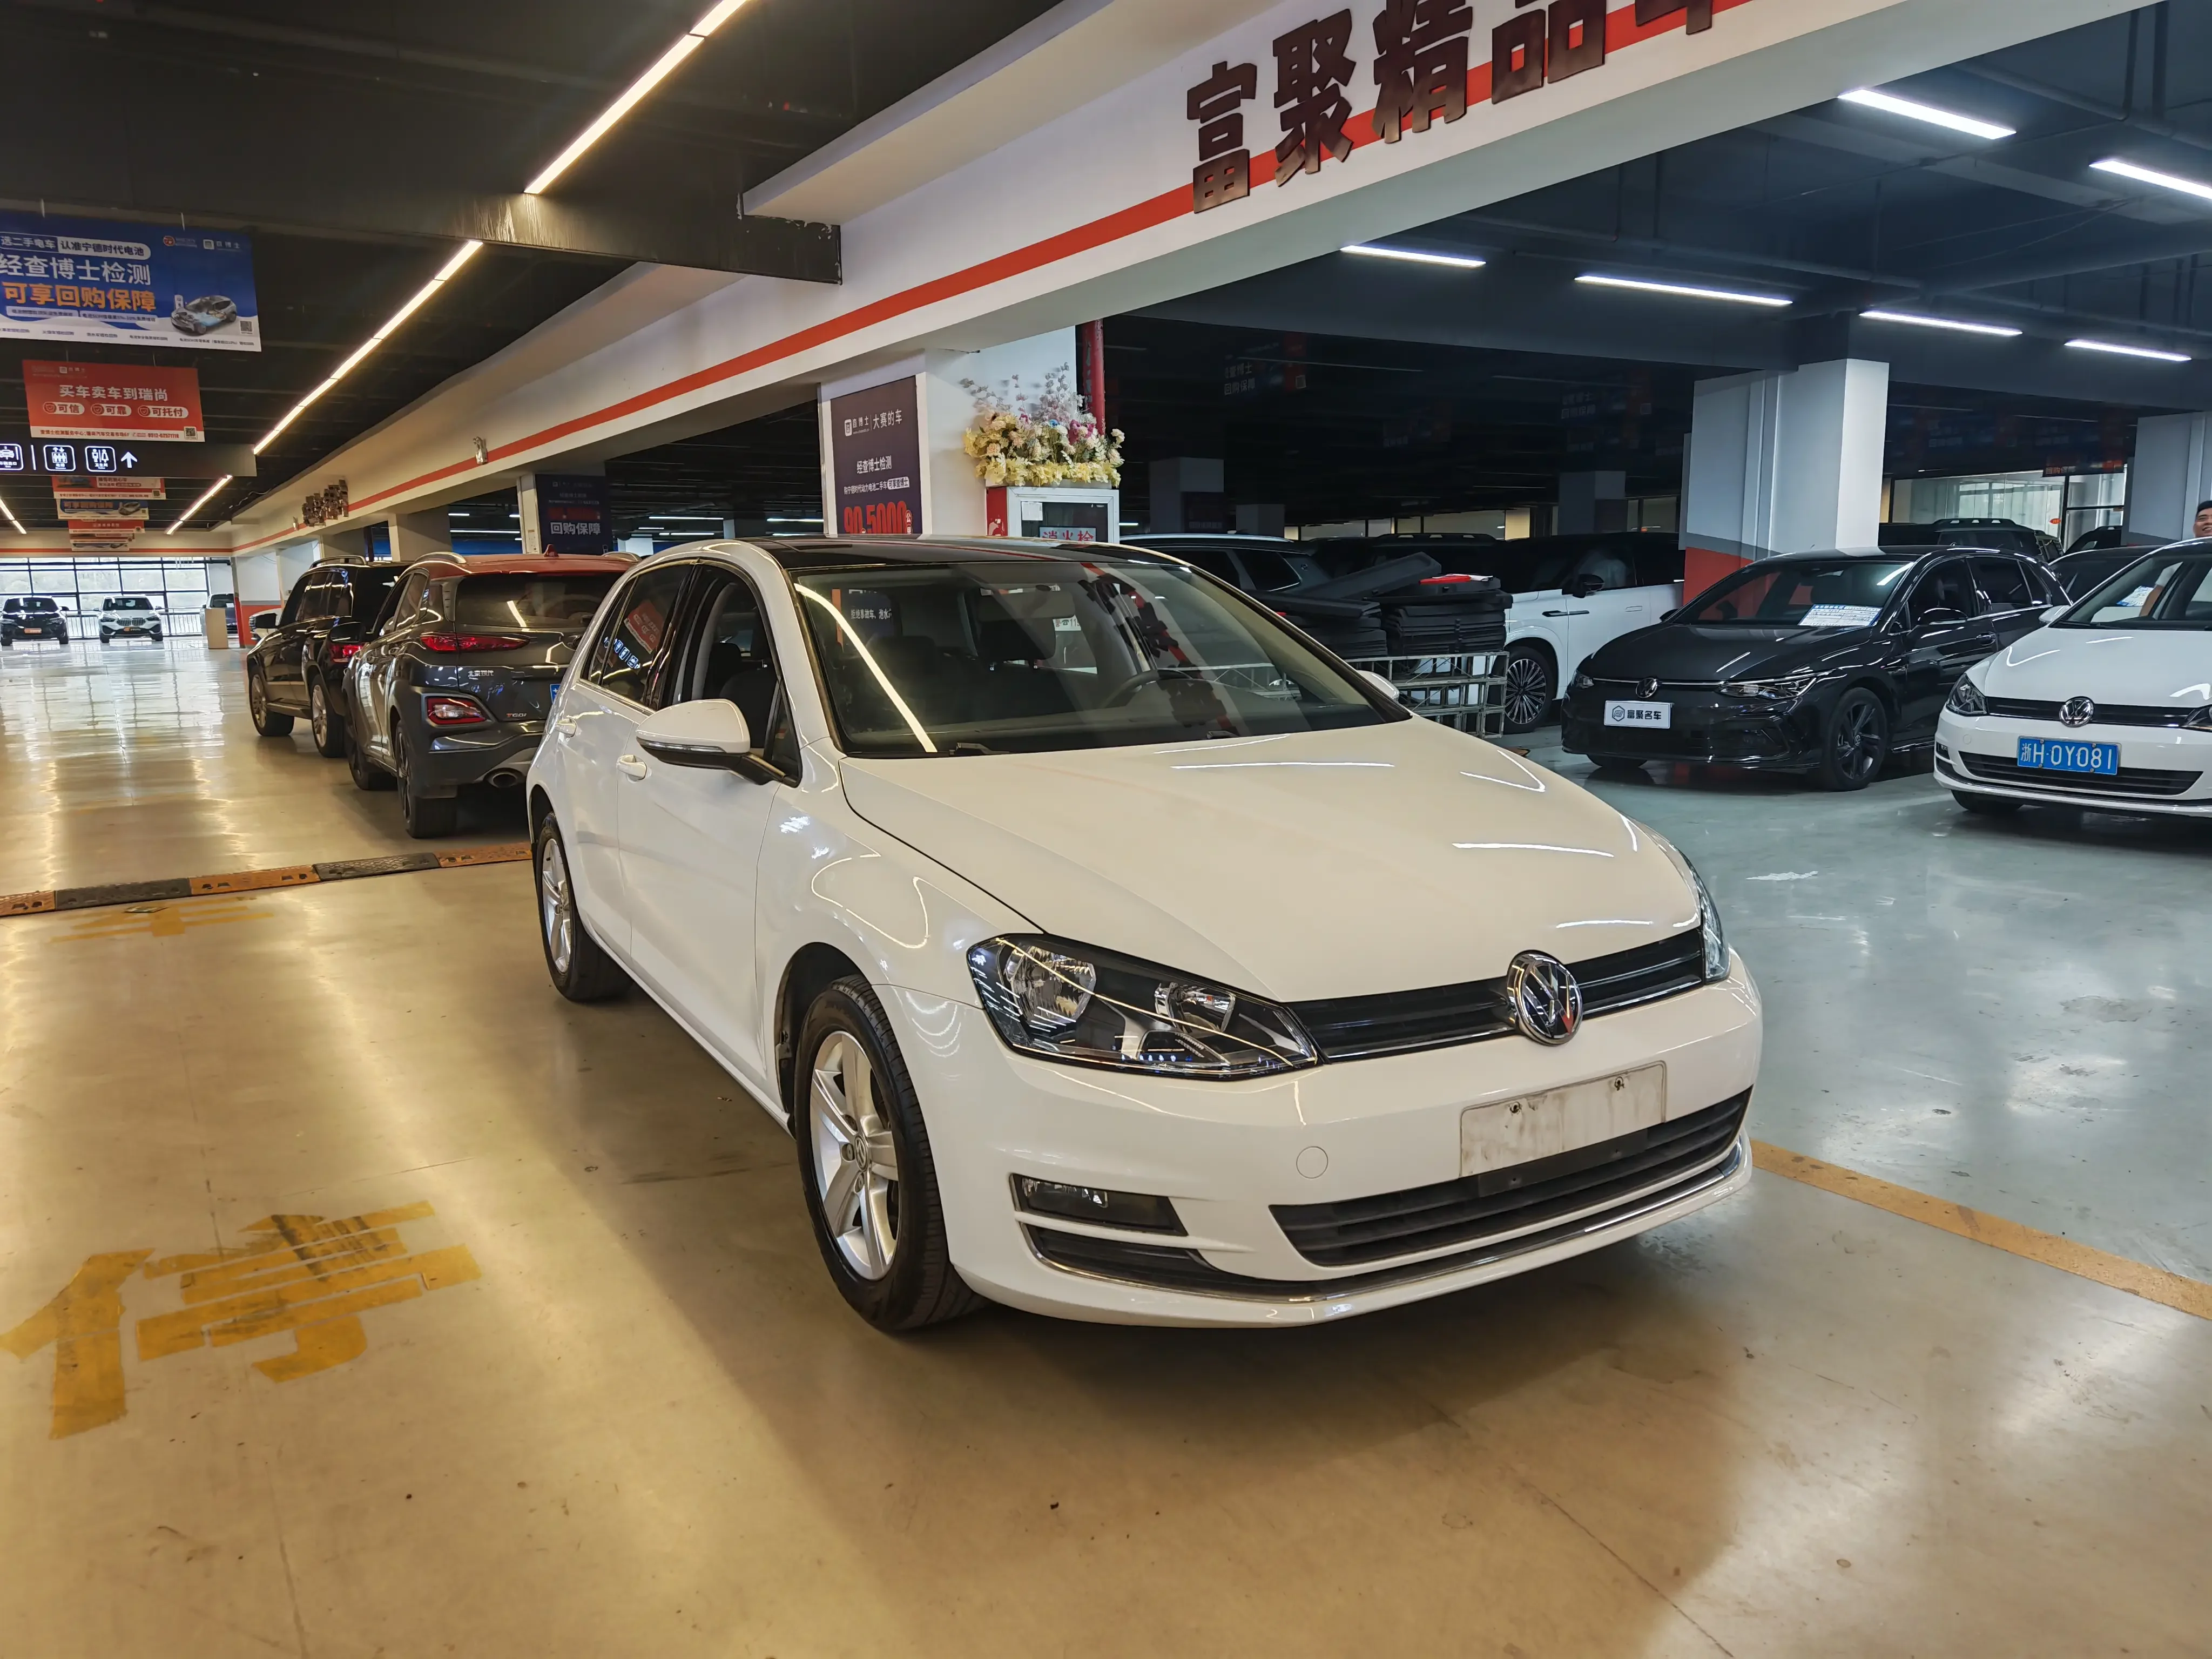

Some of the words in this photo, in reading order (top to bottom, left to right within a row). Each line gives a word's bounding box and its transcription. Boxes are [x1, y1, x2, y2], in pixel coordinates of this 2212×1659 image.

[60, 240, 144, 257] 认准宁德时代电池
[0, 254, 151, 286] 经查博士检测
[2, 281, 157, 312] 可享回购保障
[59, 385, 168, 402] 买车卖车到瑞尚
[57, 404, 79, 413] 可信
[106, 406, 127, 415] 可靠
[152, 408, 184, 417] 可托付
[856, 455, 892, 474] 经查博士检测
[888, 477, 908, 489] 可享查博士
[550, 522, 601, 535] 回购保障
[1627, 710, 1662, 720] 富聚名车
